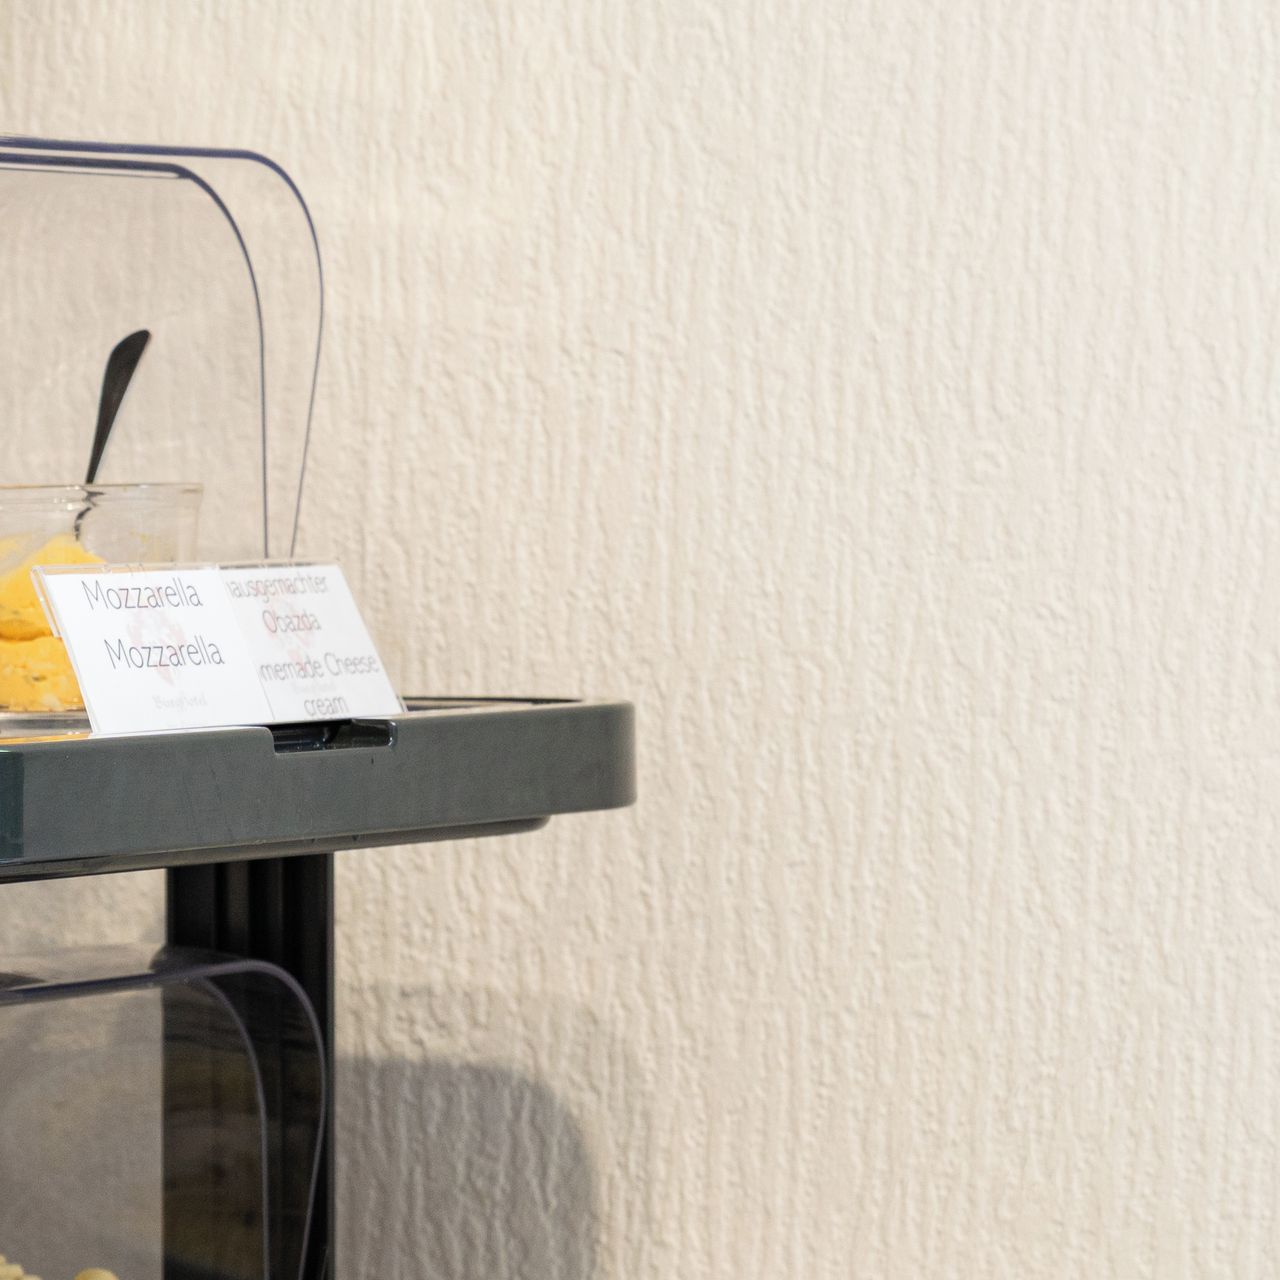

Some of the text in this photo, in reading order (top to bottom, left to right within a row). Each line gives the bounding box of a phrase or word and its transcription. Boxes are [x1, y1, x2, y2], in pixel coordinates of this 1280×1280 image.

[81, 577, 203, 610] Mozzarella
[104, 635, 225, 670] Mozzarella
[260, 652, 380, 681] memade Cheese
[303, 695, 349, 716] cream
